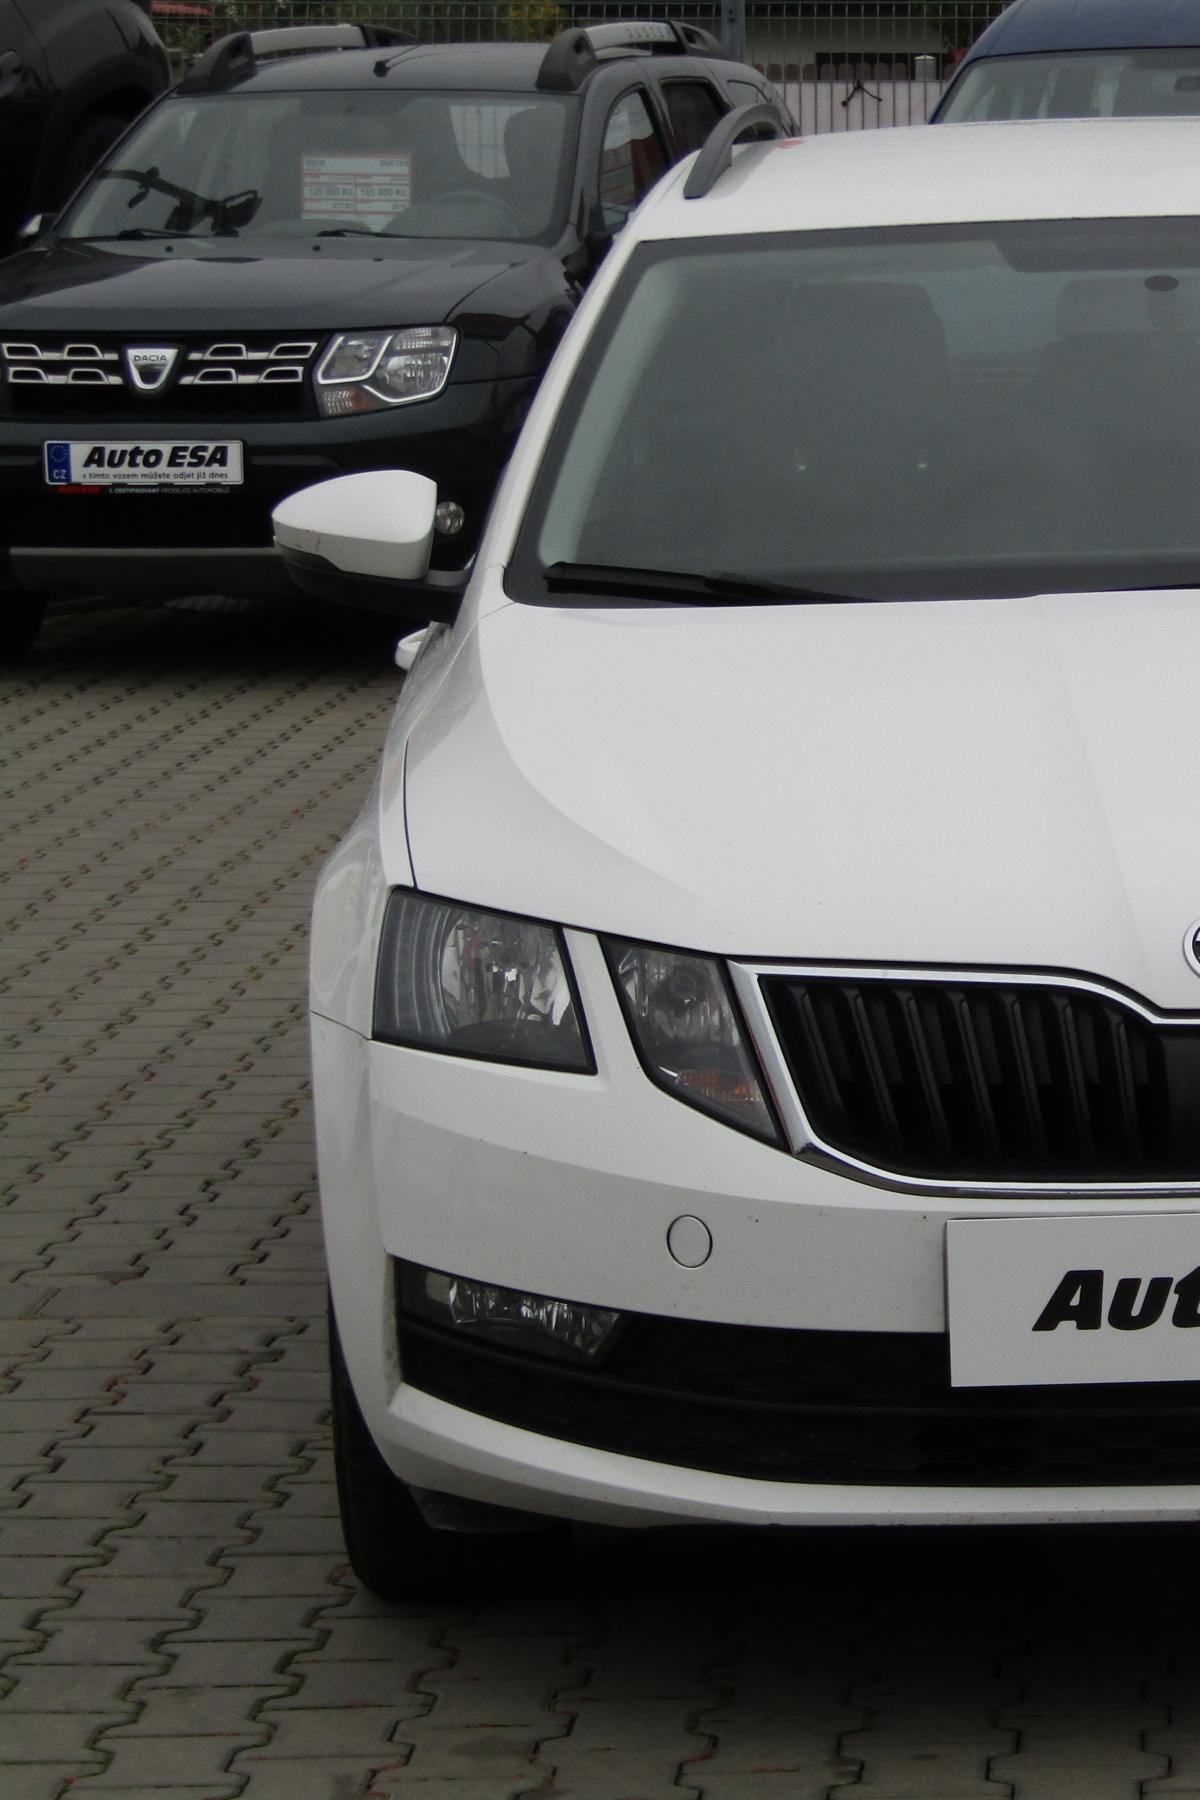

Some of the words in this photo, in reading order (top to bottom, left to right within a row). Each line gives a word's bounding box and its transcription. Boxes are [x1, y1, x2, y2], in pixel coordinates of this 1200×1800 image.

[83, 446, 163, 468] Auto
[167, 445, 229, 468] ESA
[54, 469, 67, 480] CZ
[173, 471, 194, 482] odjet
[209, 471, 229, 480] dnes
